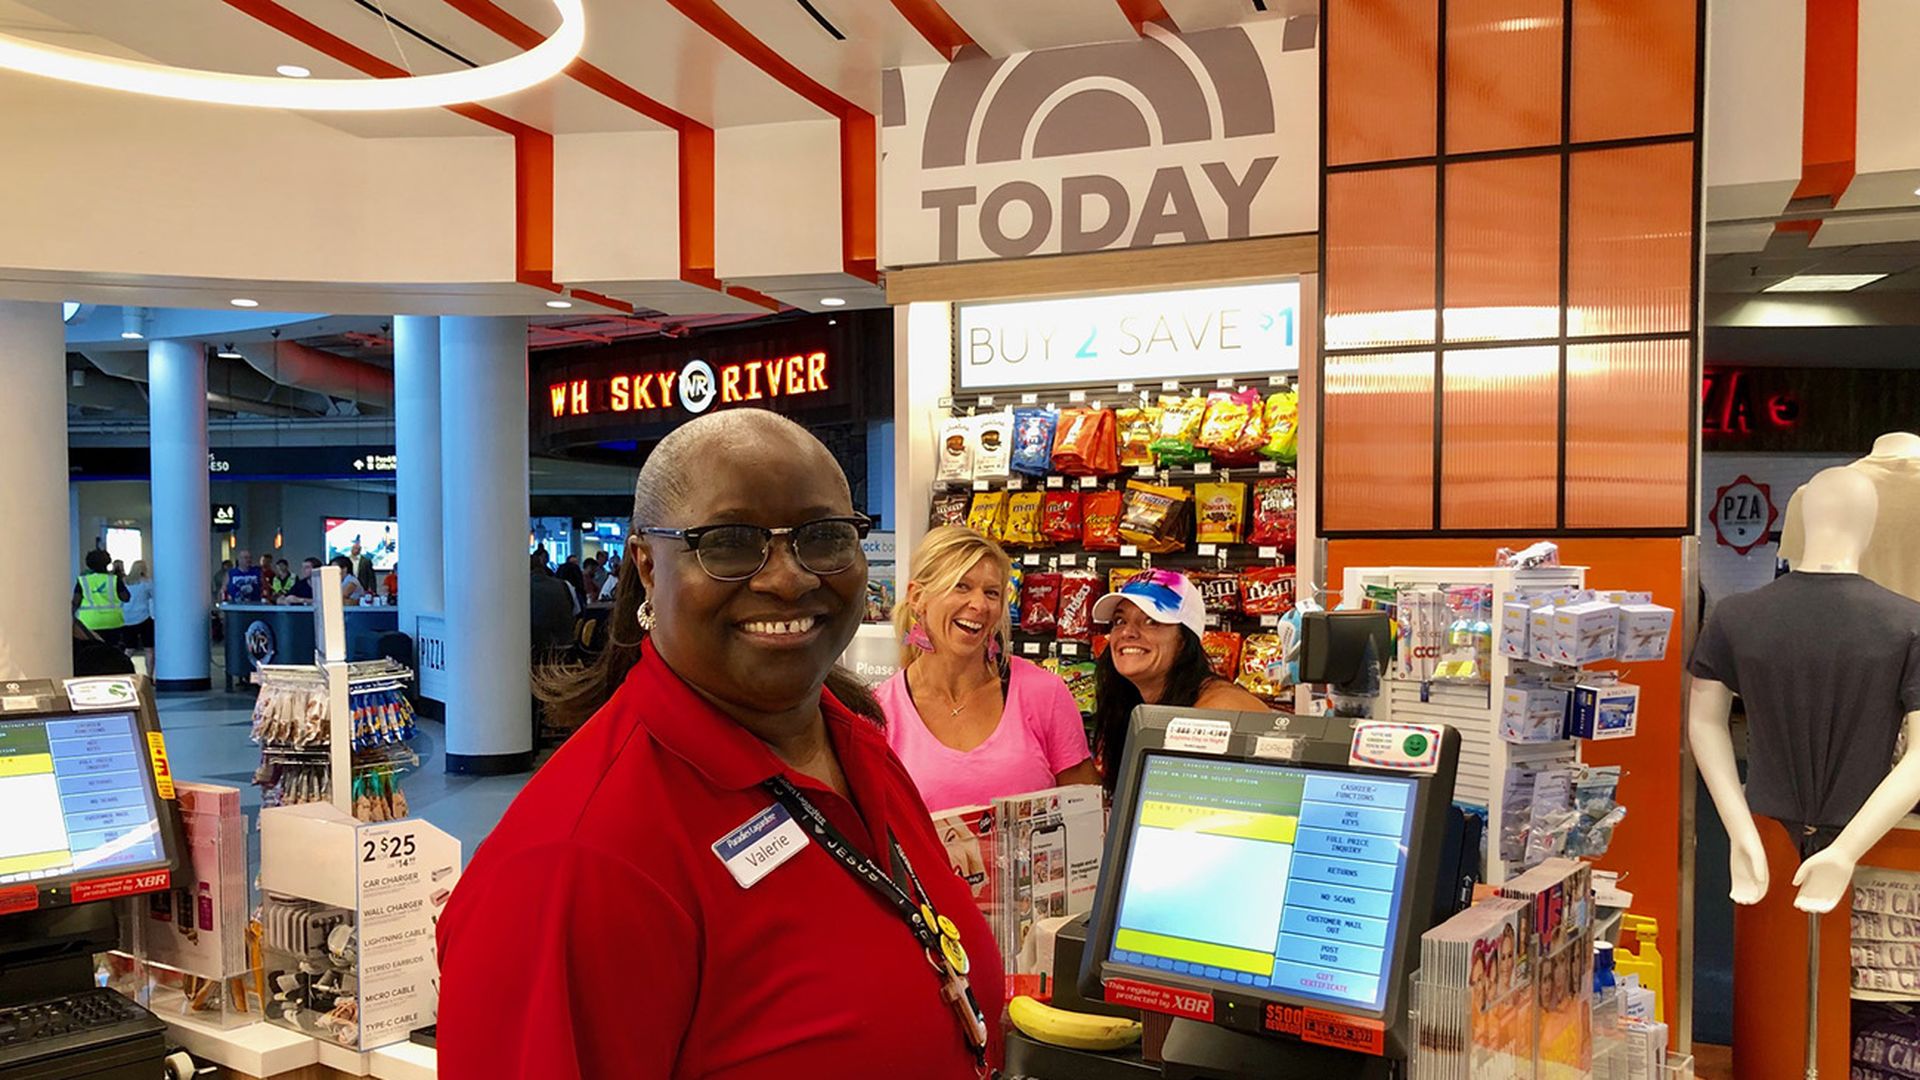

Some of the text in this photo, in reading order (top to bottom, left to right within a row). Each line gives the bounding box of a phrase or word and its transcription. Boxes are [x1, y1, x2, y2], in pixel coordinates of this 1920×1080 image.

[921, 156, 1279, 262] TODAY
[970, 325, 1056, 365] BUY
[1075, 322, 1098, 359] 2
[1119, 309, 1241, 357] SAVE
[721, 351, 830, 403] RIVER
[1723, 495, 1762, 520] PZA
[245, 634, 268, 654] WR
[420, 636, 446, 672] PIZZA
[856, 661, 895, 676] Please
[1341, 818, 1360, 827] KEYS
[362, 841, 376, 863] 2
[380, 833, 417, 859] $25
[745, 835, 790, 867] Valerie
[1326, 835, 1370, 848] FULL PRICE
[826, 839, 880, 882] JESUS
[134, 873, 167, 889] XBR
[363, 871, 419, 889] CAR CHARGER
[1327, 867, 1359, 878] RETURNS
[363, 898, 424, 918] WALL CHARGER
[1320, 893, 1356, 905] NO SCANS
[1306, 914, 1363, 930] CUSTOMER MAIL
[1326, 927, 1341, 935] OUT
[364, 927, 427, 948] LIGHTNING CABLE
[1321, 945, 1340, 954] POST
[364, 955, 424, 975] STEREO EARBUDS
[364, 984, 416, 1004] MICRO CABLE
[1108, 981, 1210, 1015] This register is XBR
[1115, 991, 1171, 1009] protected by
[365, 1012, 418, 1033] TYPE-C CABLE
[1265, 1003, 1302, 1025] $500
[1265, 1019, 1301, 1036] REWARD
